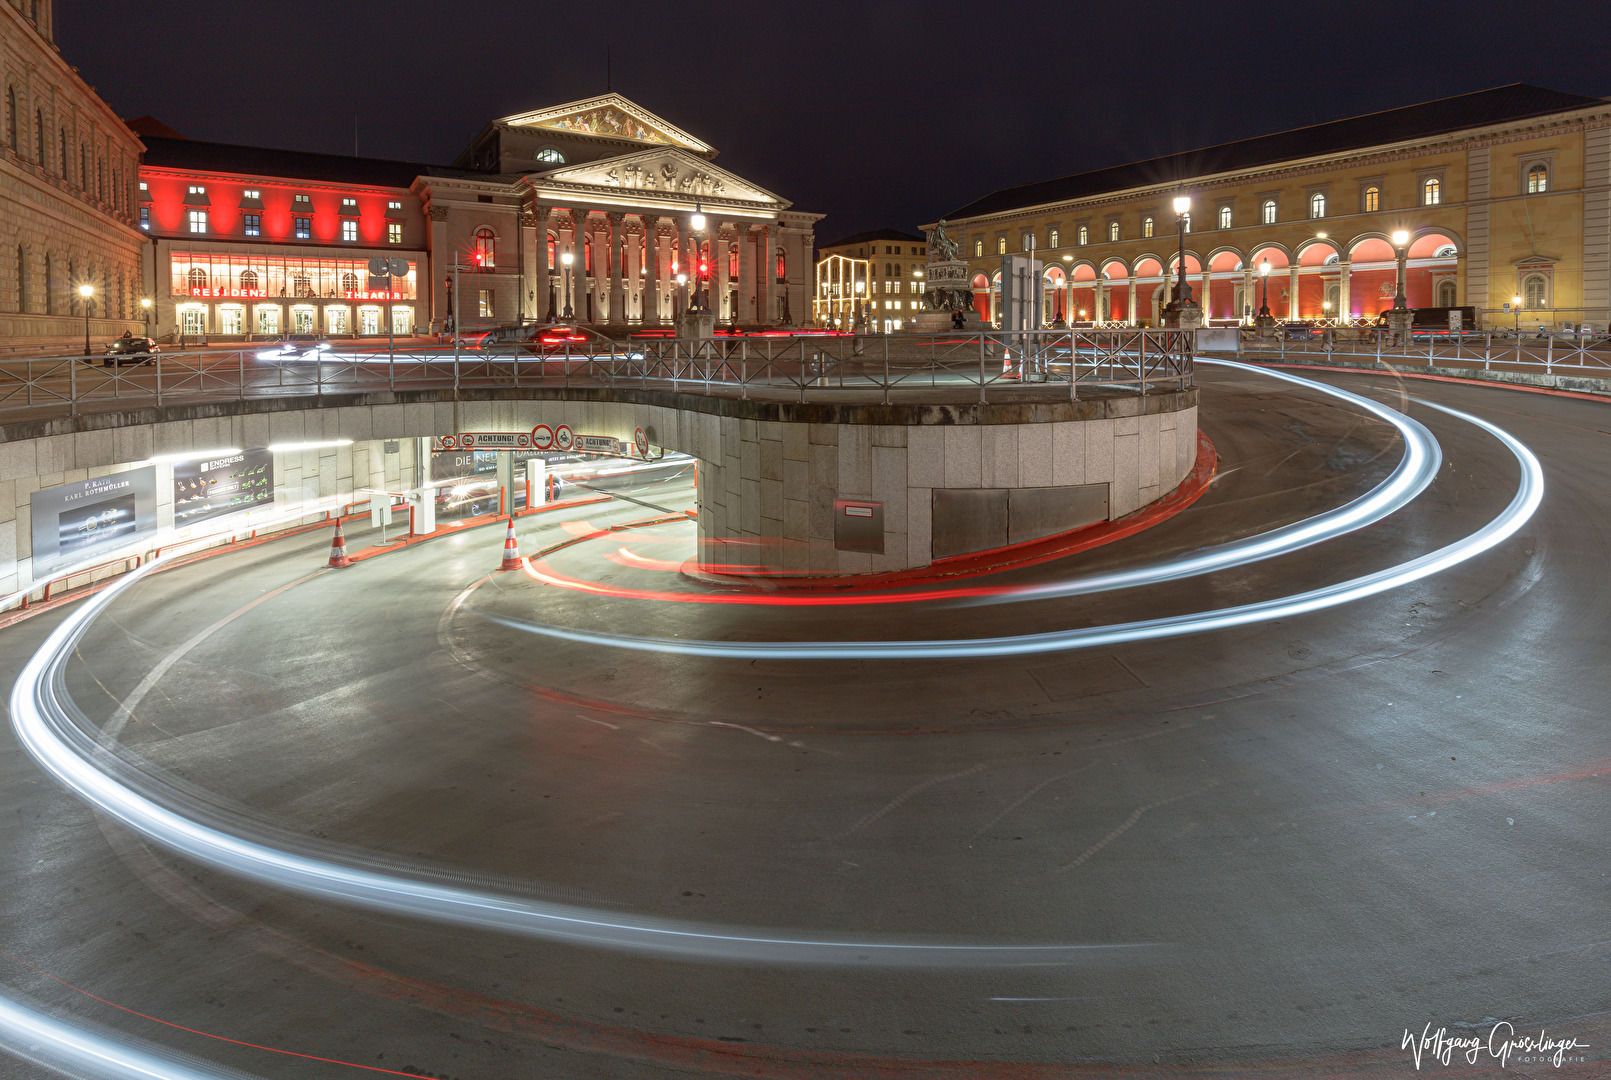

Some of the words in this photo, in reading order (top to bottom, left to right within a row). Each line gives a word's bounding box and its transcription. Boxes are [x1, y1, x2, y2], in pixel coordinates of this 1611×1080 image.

[193, 288, 266, 298] RESIDENZ
[585, 437, 611, 447] ACHTUNG!
[209, 455, 245, 467] ENDRESS
[455, 455, 471, 467] DIE
[92, 478, 111, 488] RATH
[64, 492, 83, 502] KARL
[85, 480, 131, 497] ROTHMÜLLER
